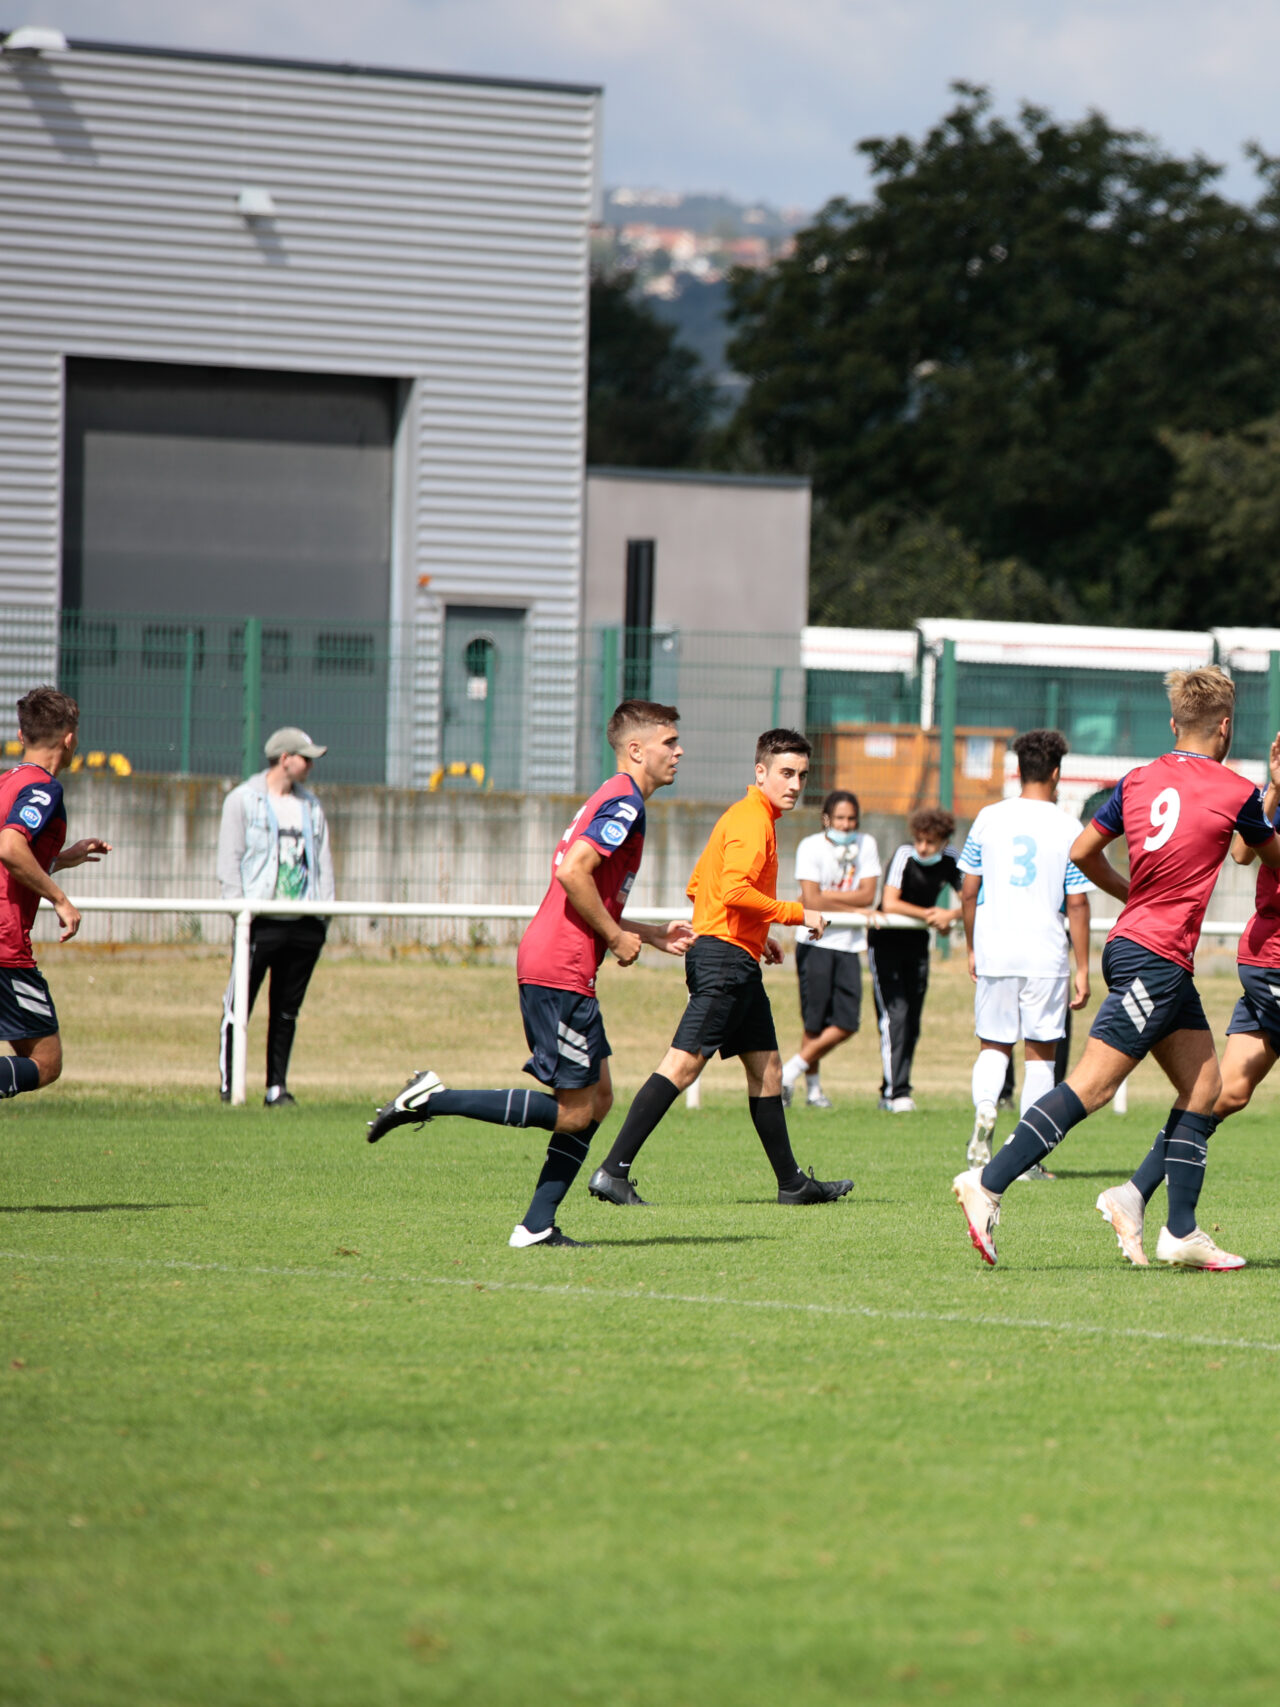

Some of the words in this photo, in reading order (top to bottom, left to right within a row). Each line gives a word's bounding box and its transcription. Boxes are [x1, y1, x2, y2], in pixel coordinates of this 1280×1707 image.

[606, 824, 623, 838] U17
[1142, 787, 1181, 852] 9
[1009, 835, 1038, 888] 3
